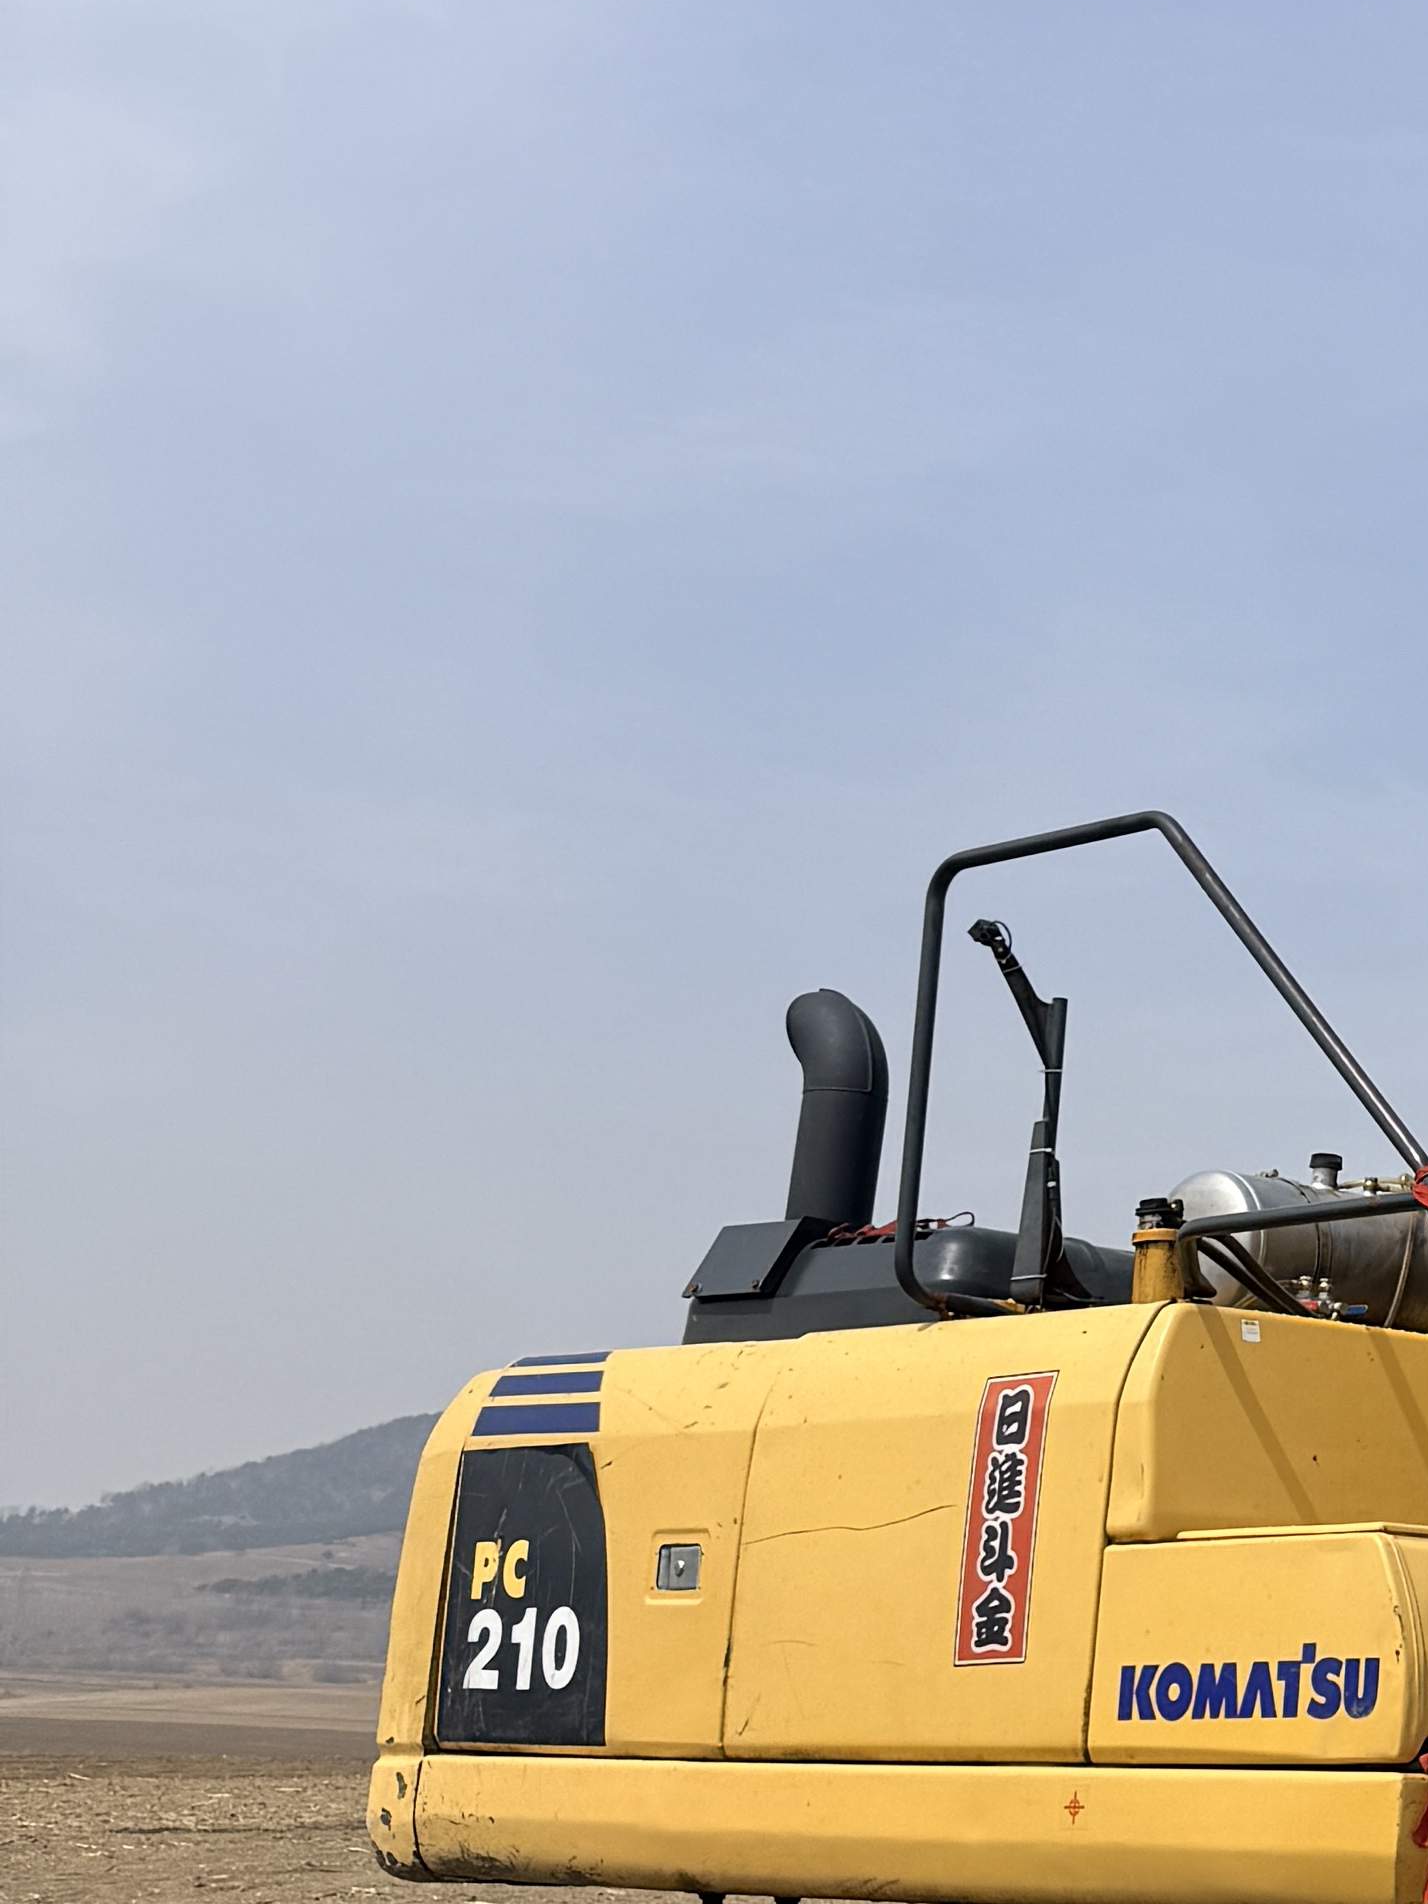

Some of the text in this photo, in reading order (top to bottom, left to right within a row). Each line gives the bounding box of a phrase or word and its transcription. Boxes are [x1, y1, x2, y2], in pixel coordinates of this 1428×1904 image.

[973, 1388, 1032, 1649] 日進斗金
[470, 1539, 530, 1600] PC
[463, 1605, 580, 1691] 210
[1117, 1642, 1381, 1721] KOMATSU
